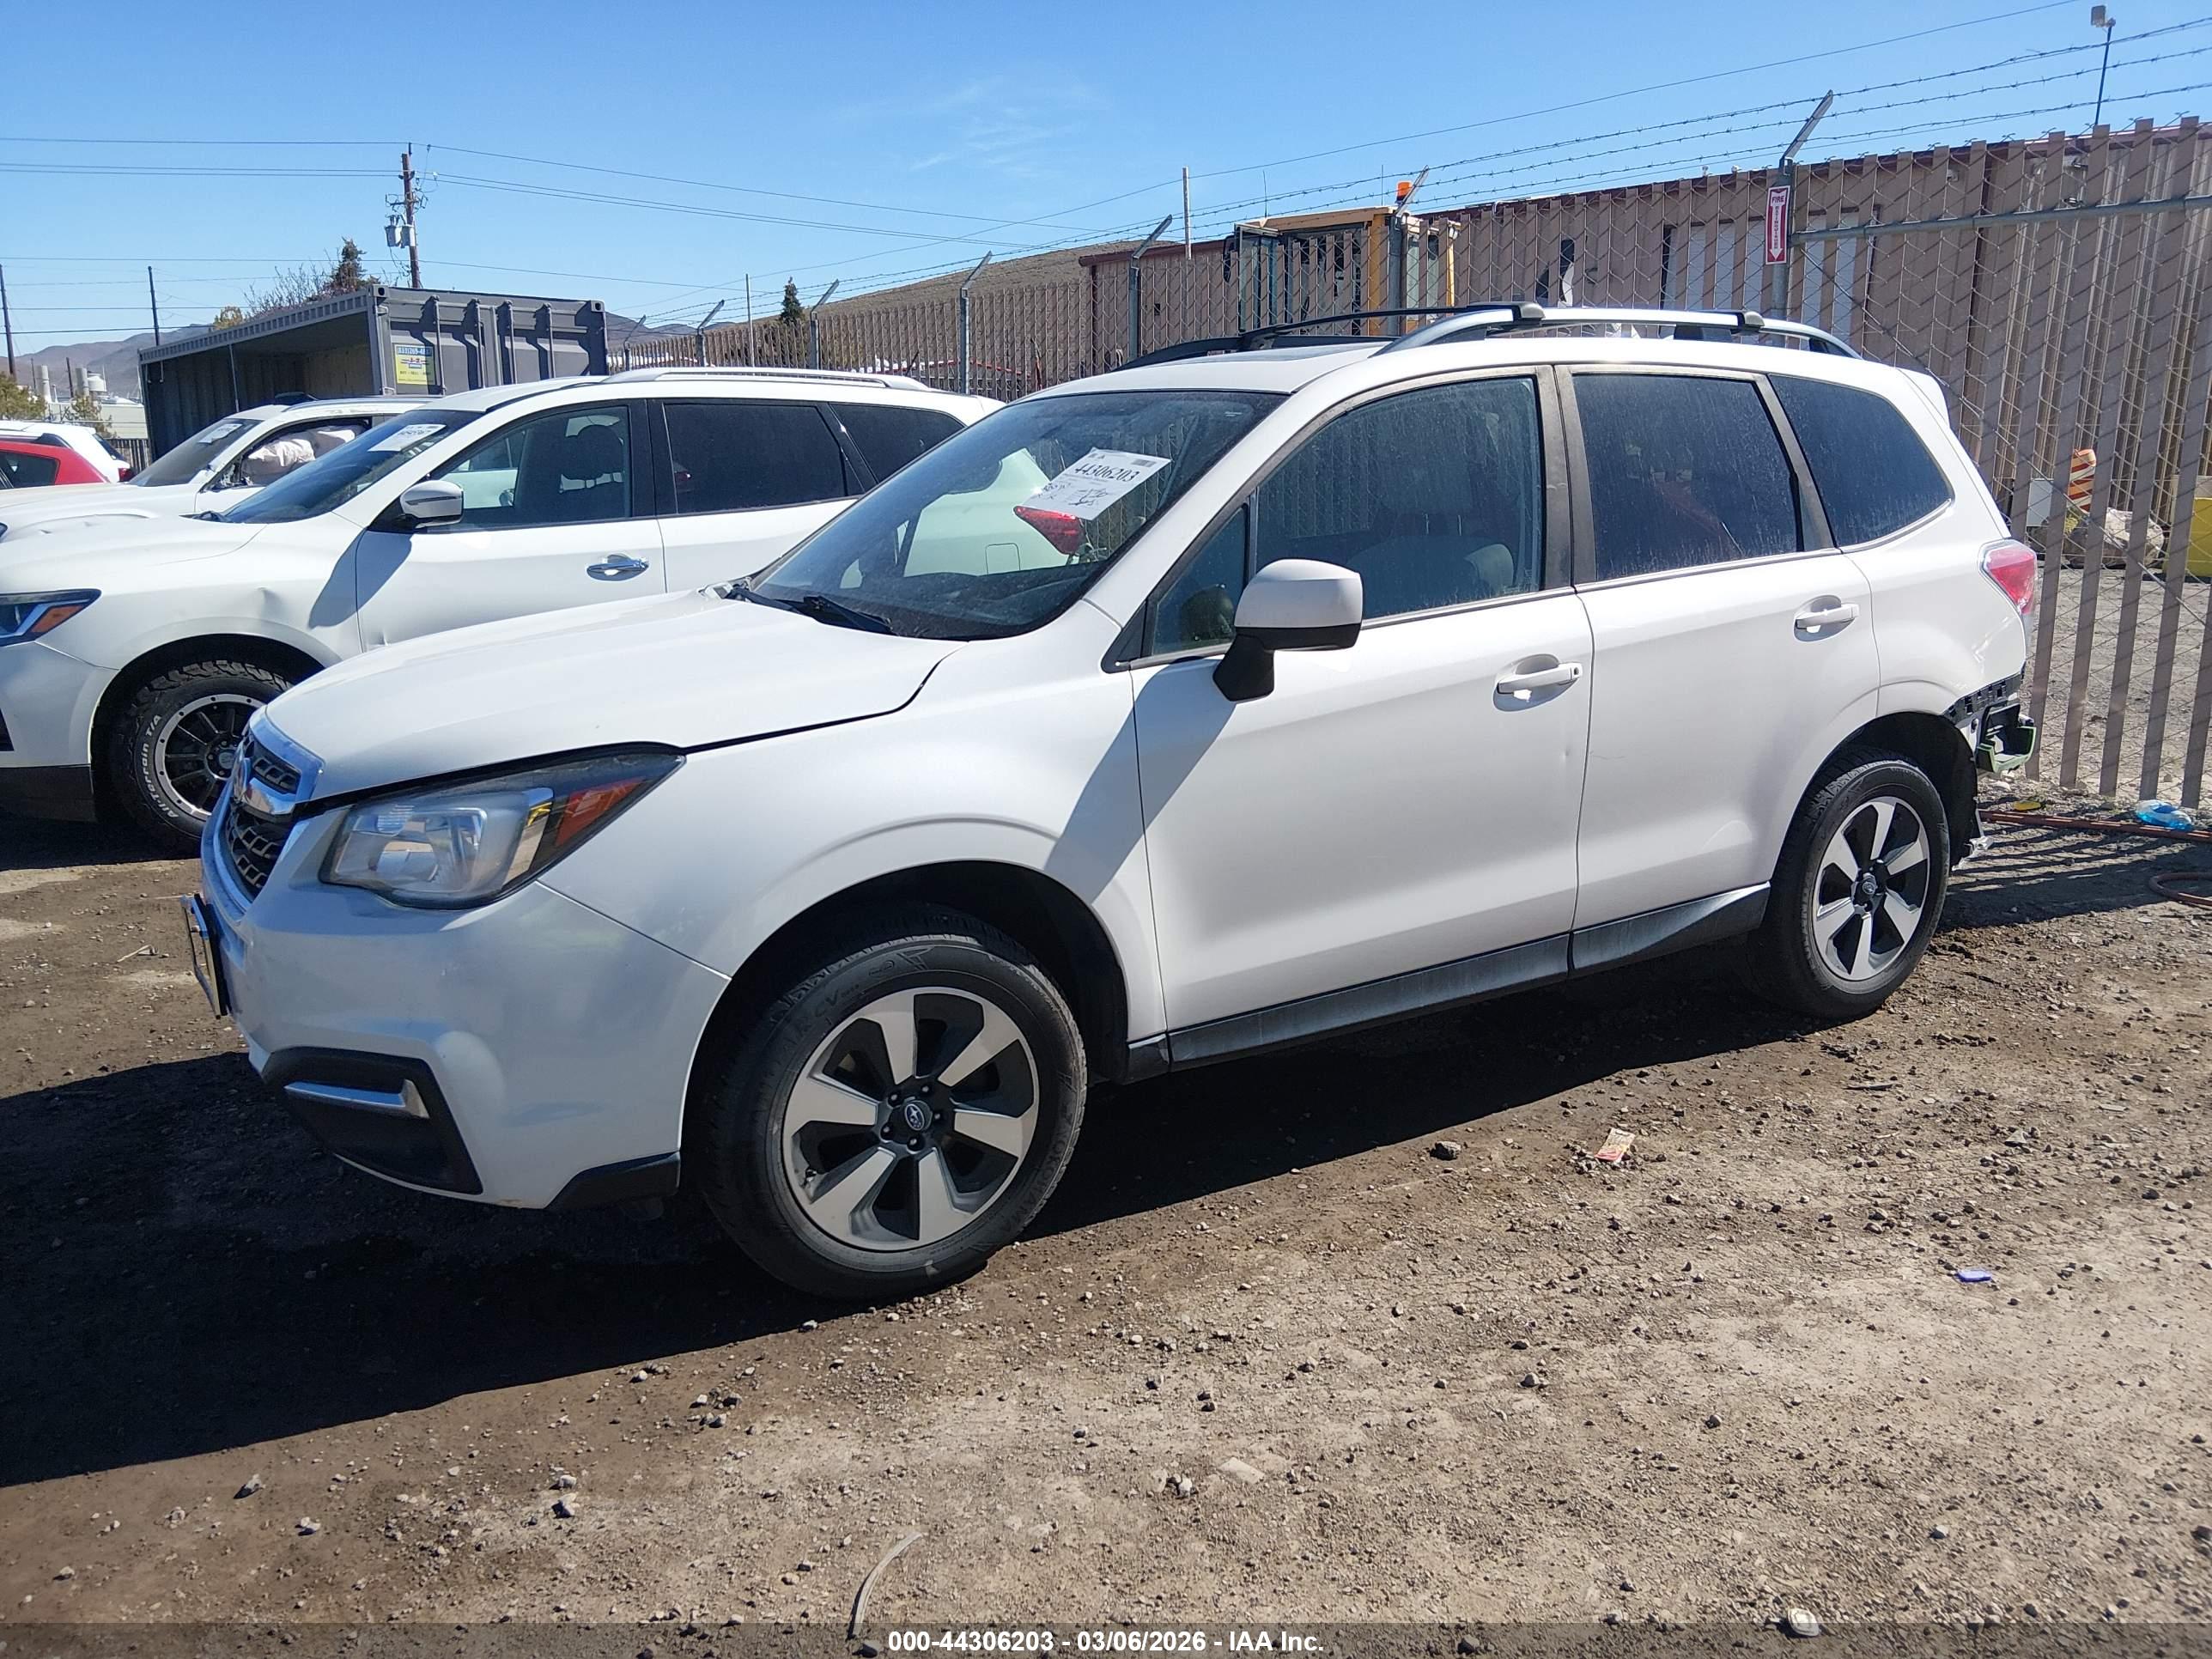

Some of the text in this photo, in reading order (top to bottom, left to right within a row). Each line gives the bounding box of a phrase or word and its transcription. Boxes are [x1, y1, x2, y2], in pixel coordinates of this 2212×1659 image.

[1074, 463, 1140, 483] 44306203
[141, 714, 179, 818] All-Terrain T/A
